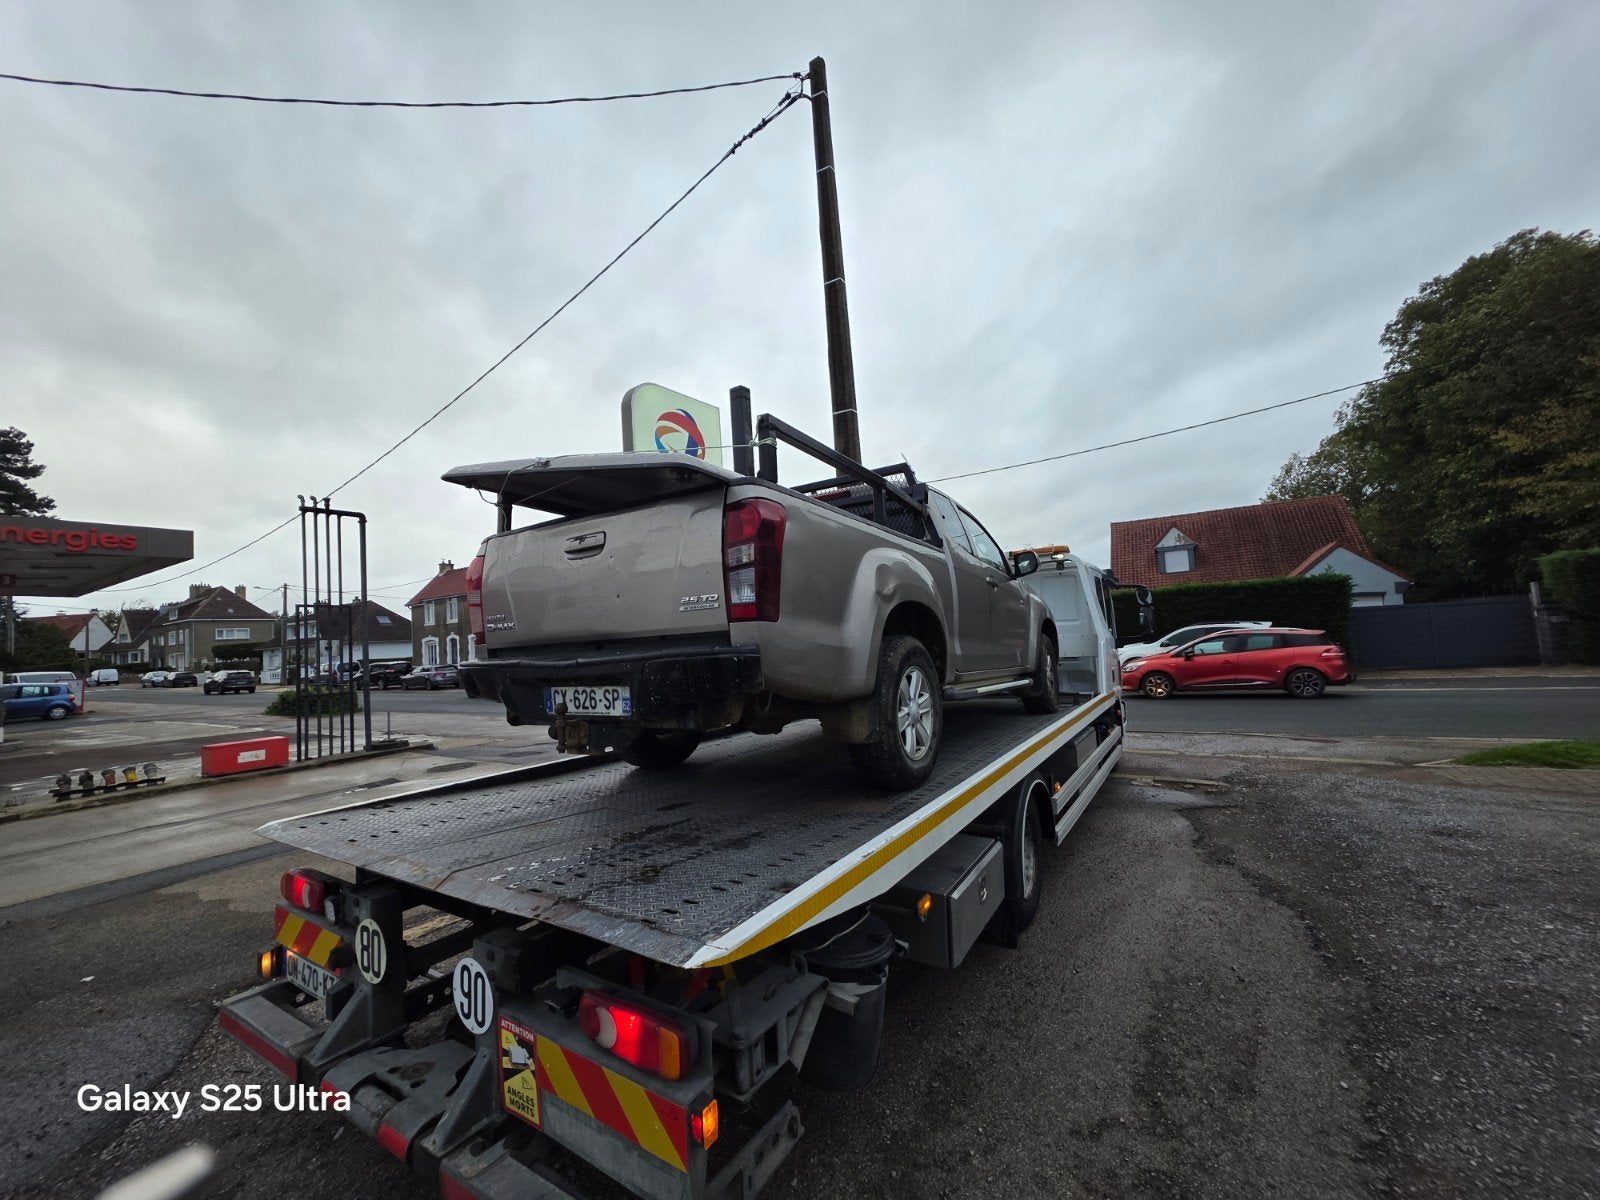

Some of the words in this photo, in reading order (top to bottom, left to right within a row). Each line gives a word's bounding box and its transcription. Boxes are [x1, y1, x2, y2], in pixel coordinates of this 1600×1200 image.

[0, 525, 137, 552] nergies
[623, 700, 631, 711] 62
[360, 925, 381, 978] 80
[460, 964, 486, 1028] 90
[501, 1018, 535, 1042] ATTENTION
[507, 1084, 535, 1108] ANGLES
[509, 1096, 535, 1118] MORTS
